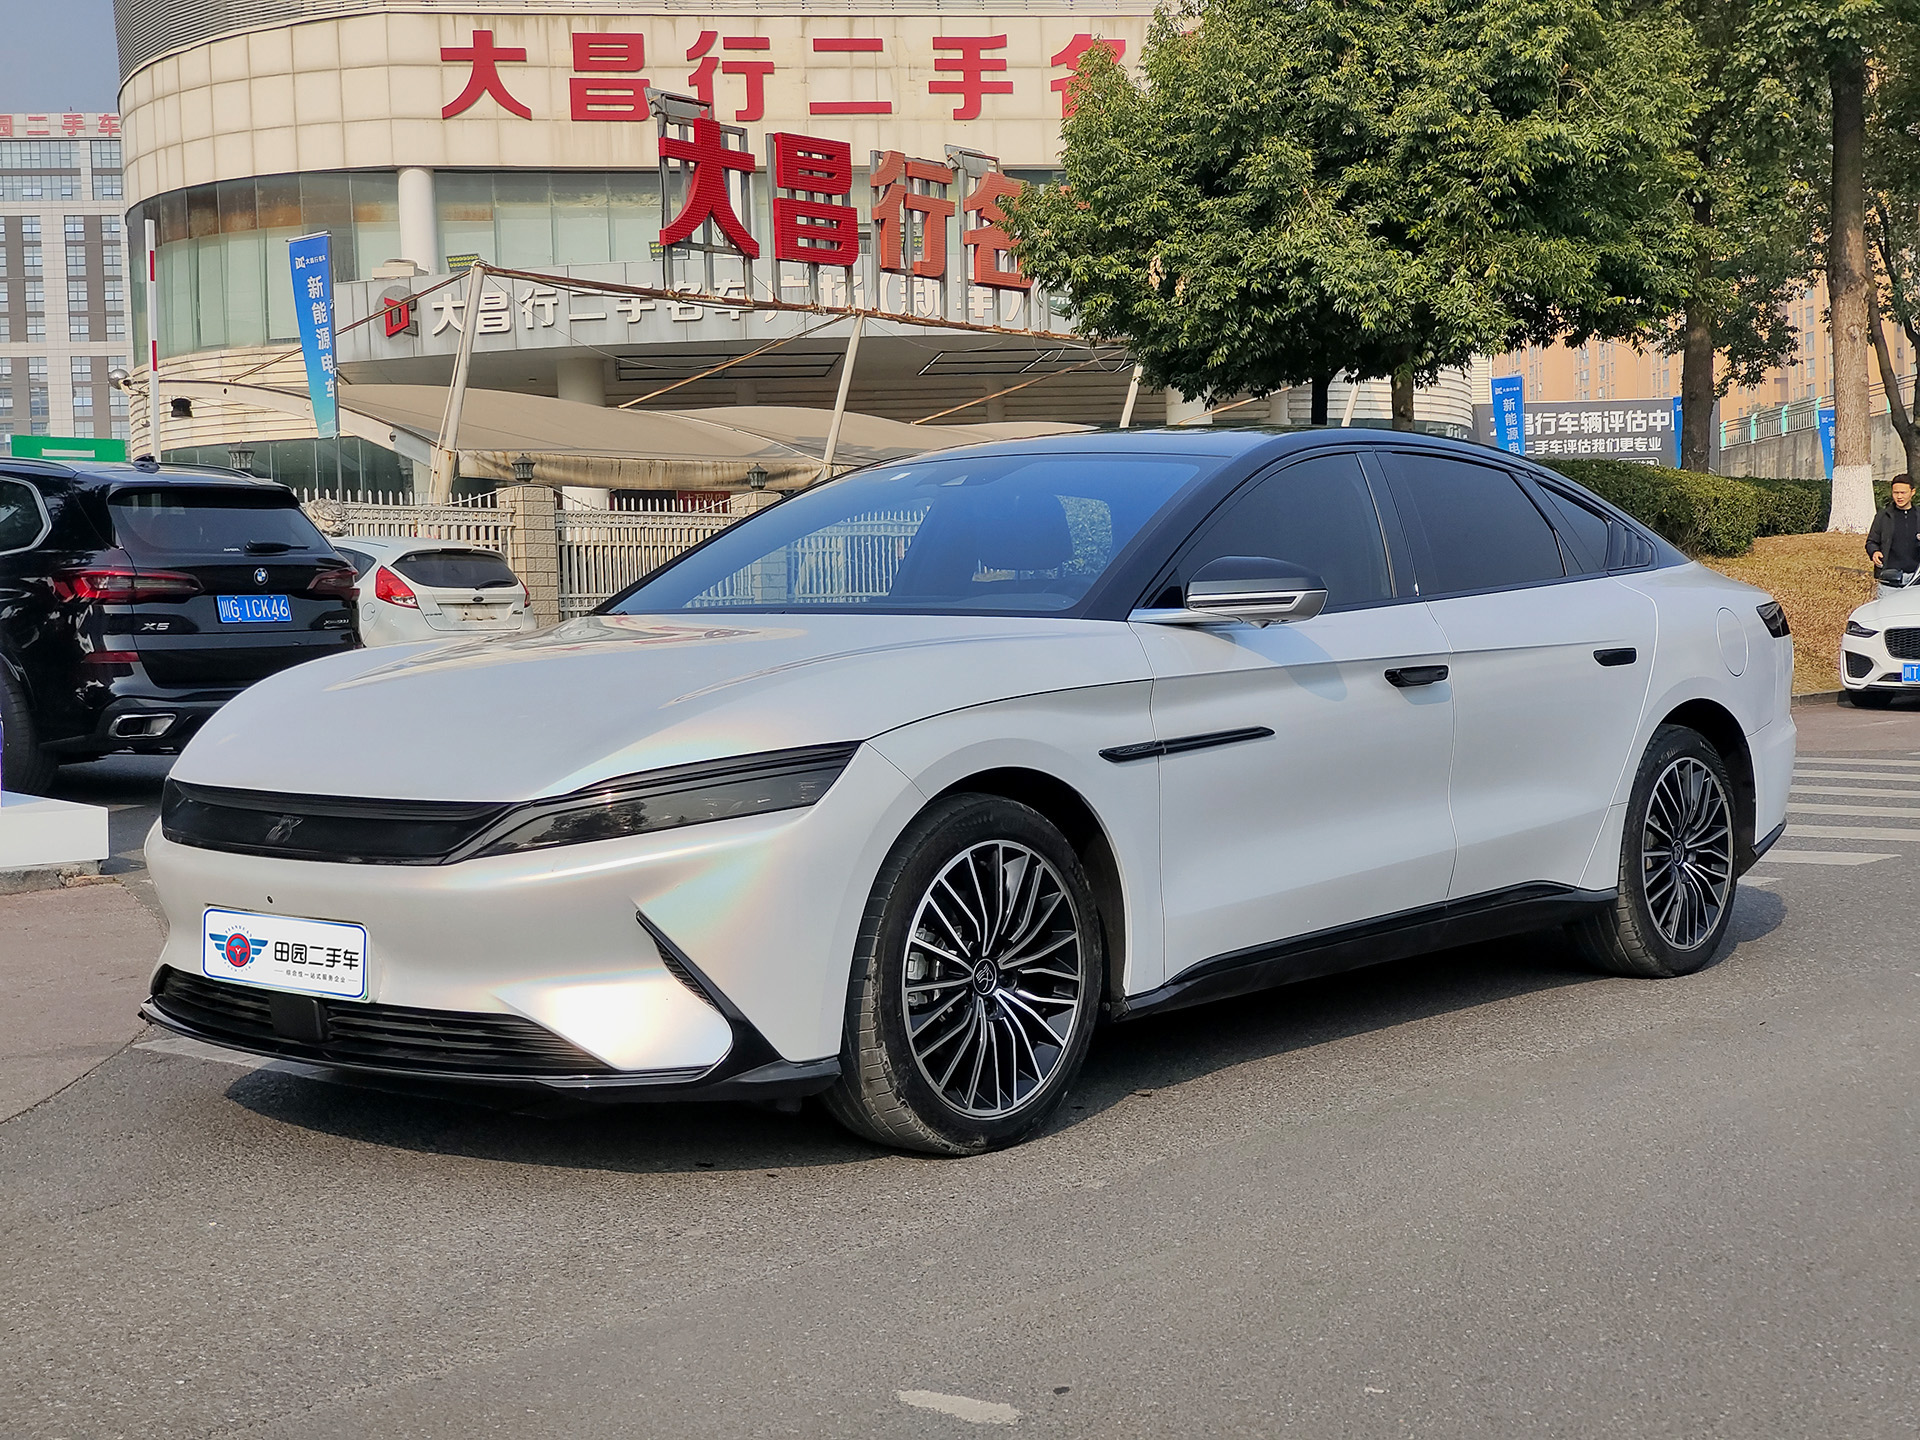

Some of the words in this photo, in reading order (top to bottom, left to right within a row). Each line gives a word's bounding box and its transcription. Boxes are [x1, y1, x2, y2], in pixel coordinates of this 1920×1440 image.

[141, 622, 170, 631] X5
[274, 941, 359, 970] 田园二手车
